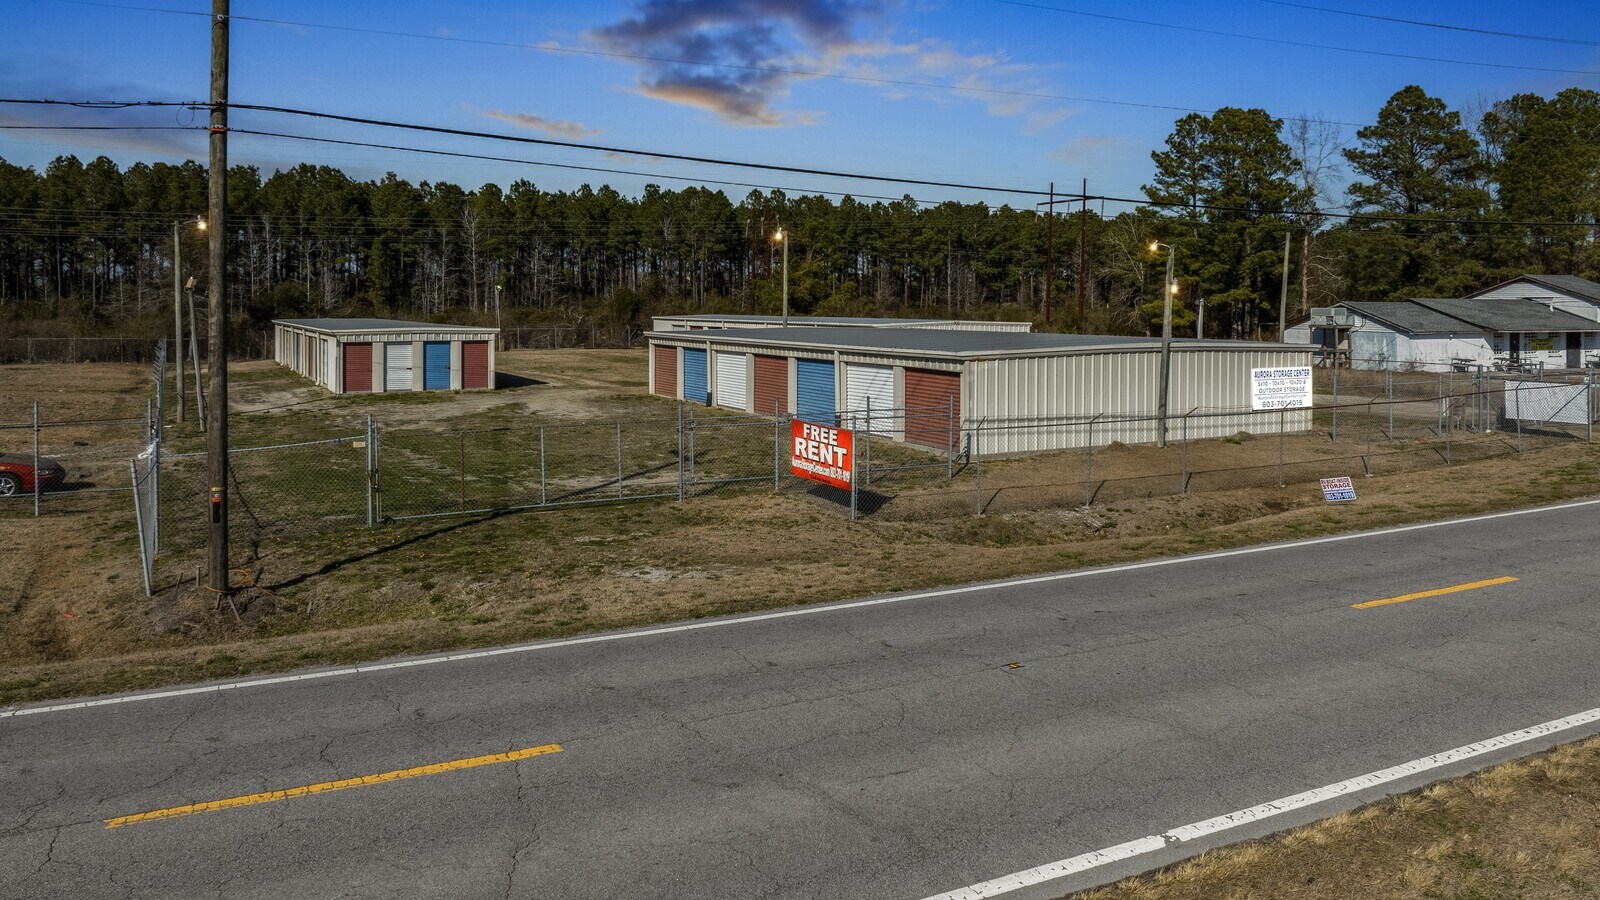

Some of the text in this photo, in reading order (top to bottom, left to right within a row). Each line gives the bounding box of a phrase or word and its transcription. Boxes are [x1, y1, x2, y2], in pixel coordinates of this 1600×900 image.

[1254, 368, 1310, 379] AURORA STORAGE CENTER
[803, 423, 838, 446] FREE
[795, 436, 847, 468] RENT
